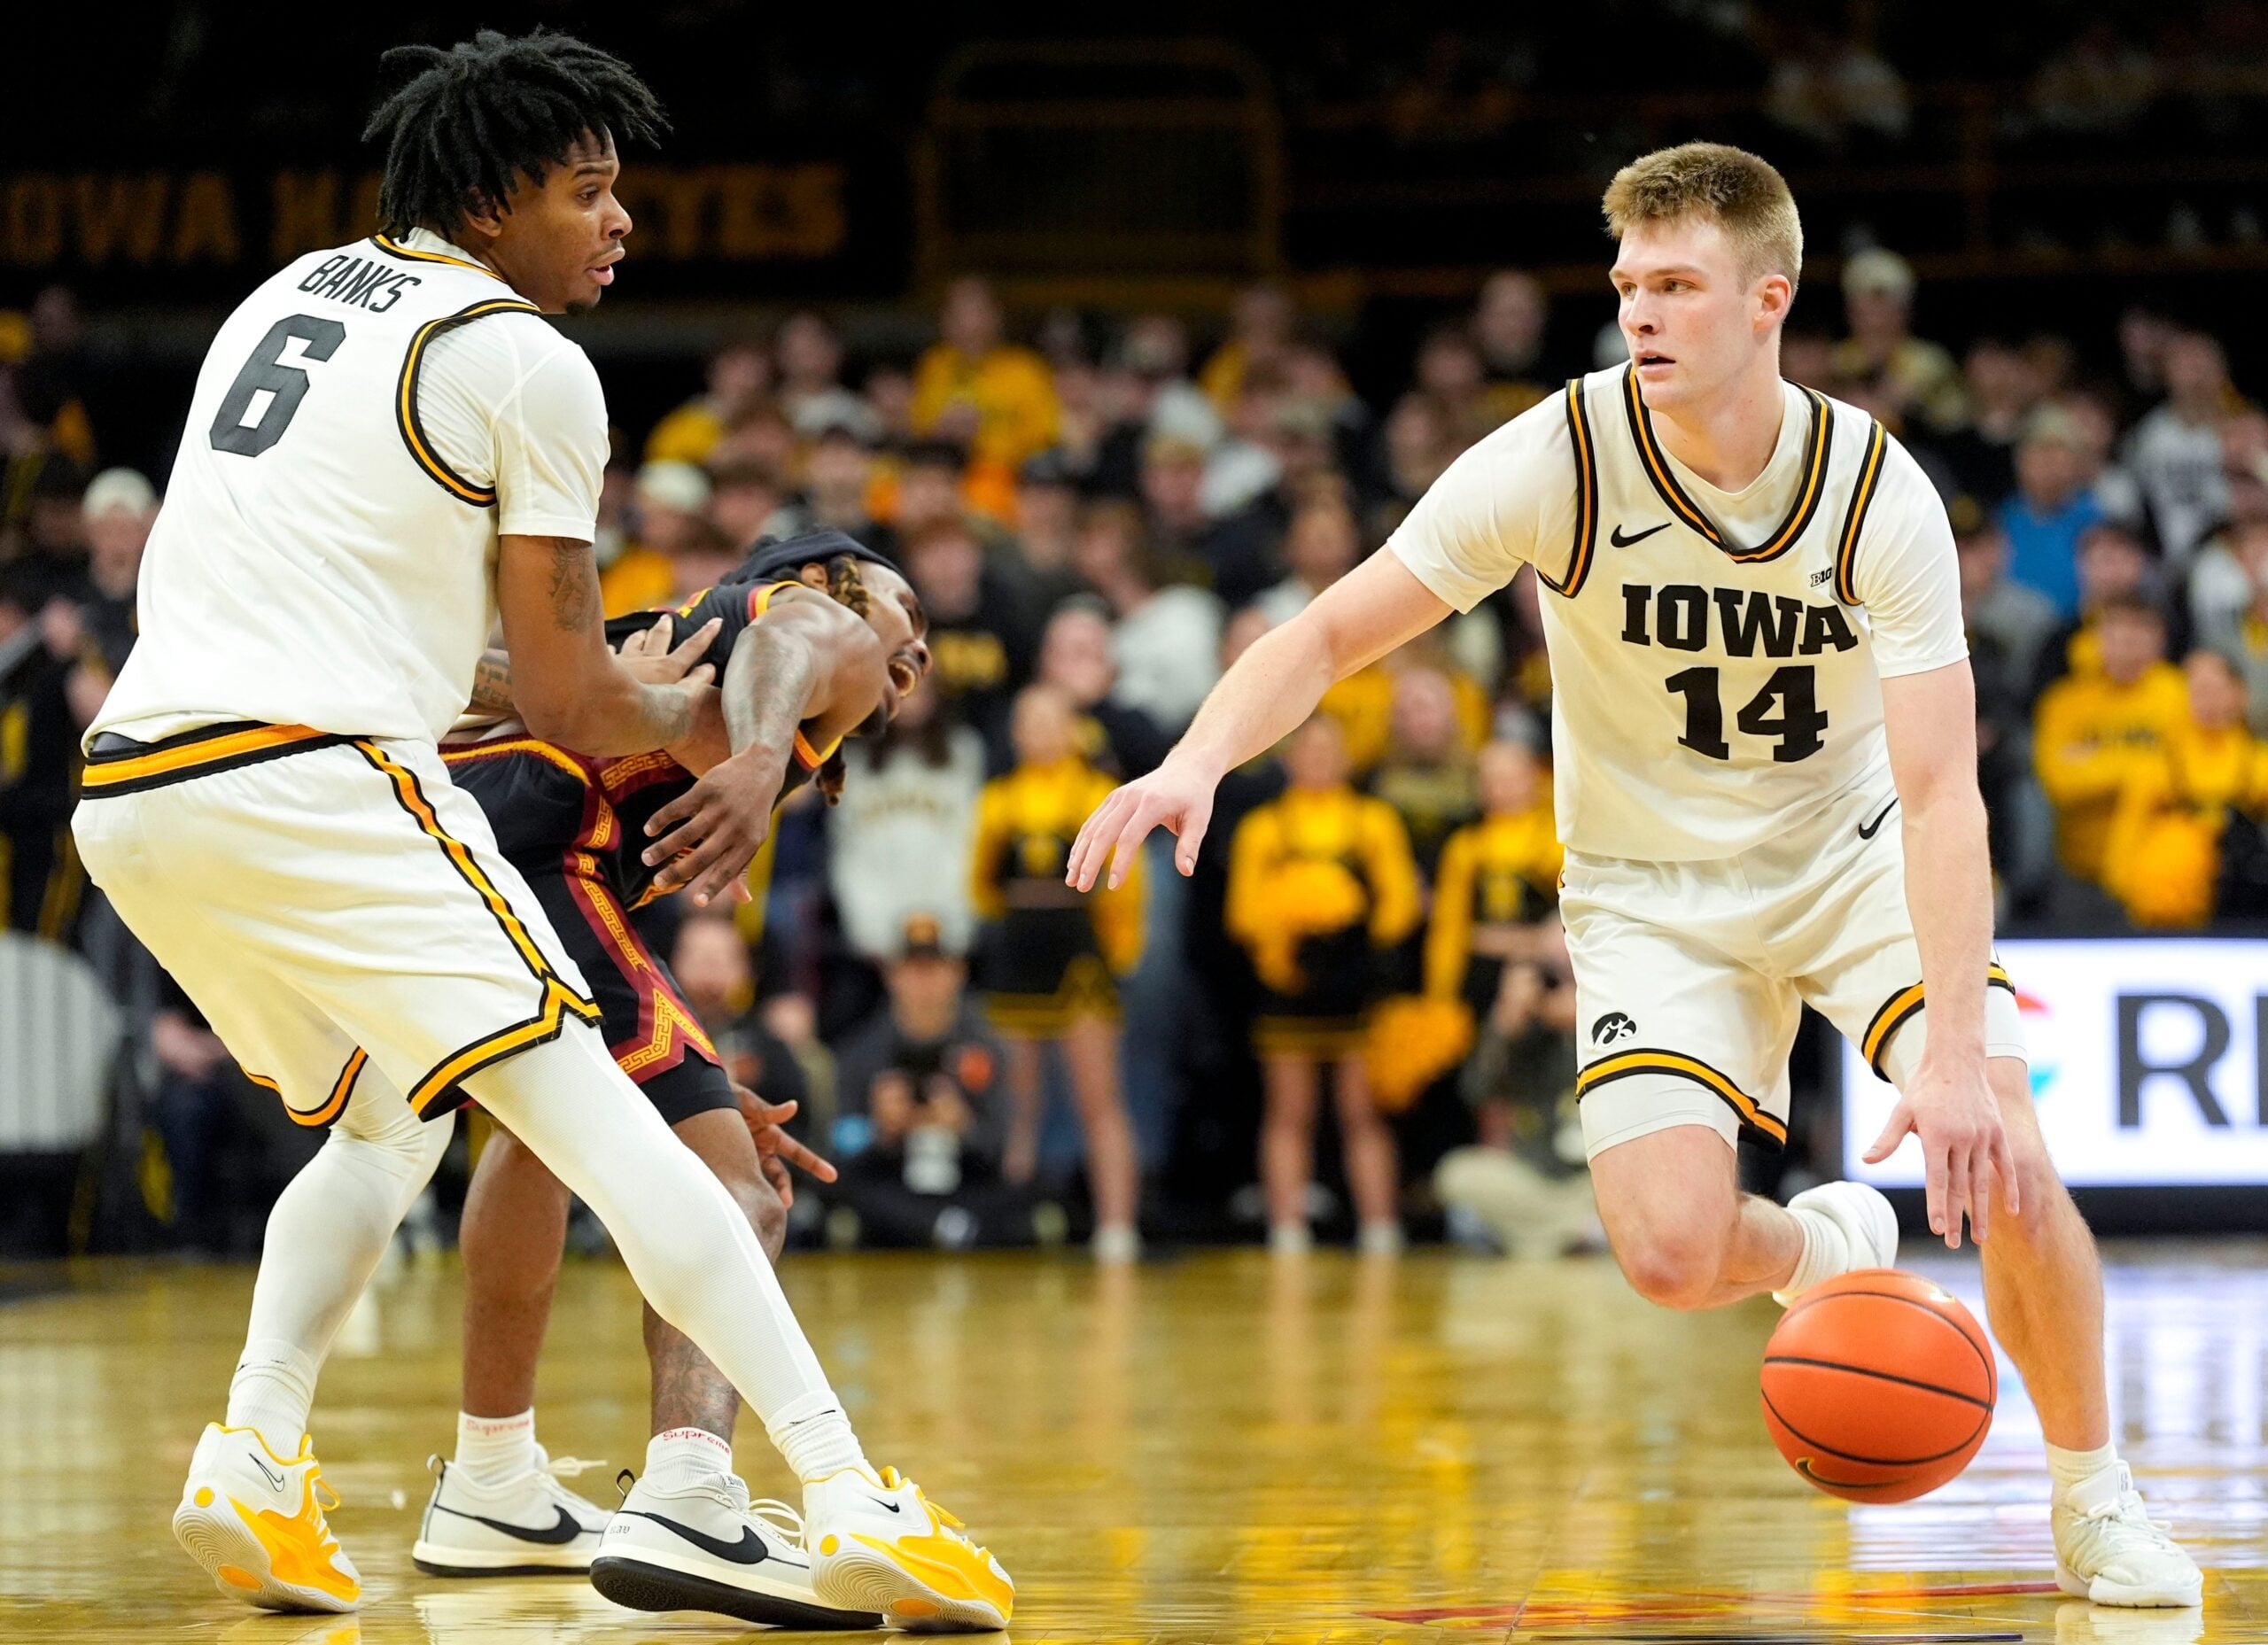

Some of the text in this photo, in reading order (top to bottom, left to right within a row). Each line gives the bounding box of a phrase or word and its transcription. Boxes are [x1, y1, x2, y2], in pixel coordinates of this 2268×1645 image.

[0, 170, 239, 266] OWA
[298, 255, 422, 313] BANKS
[209, 314, 346, 458] 6
[1621, 583, 1859, 658] IOWA
[1665, 665, 1829, 763] 14
[2117, 994, 2268, 1128] R
[662, 1431, 731, 1454] Supreme
